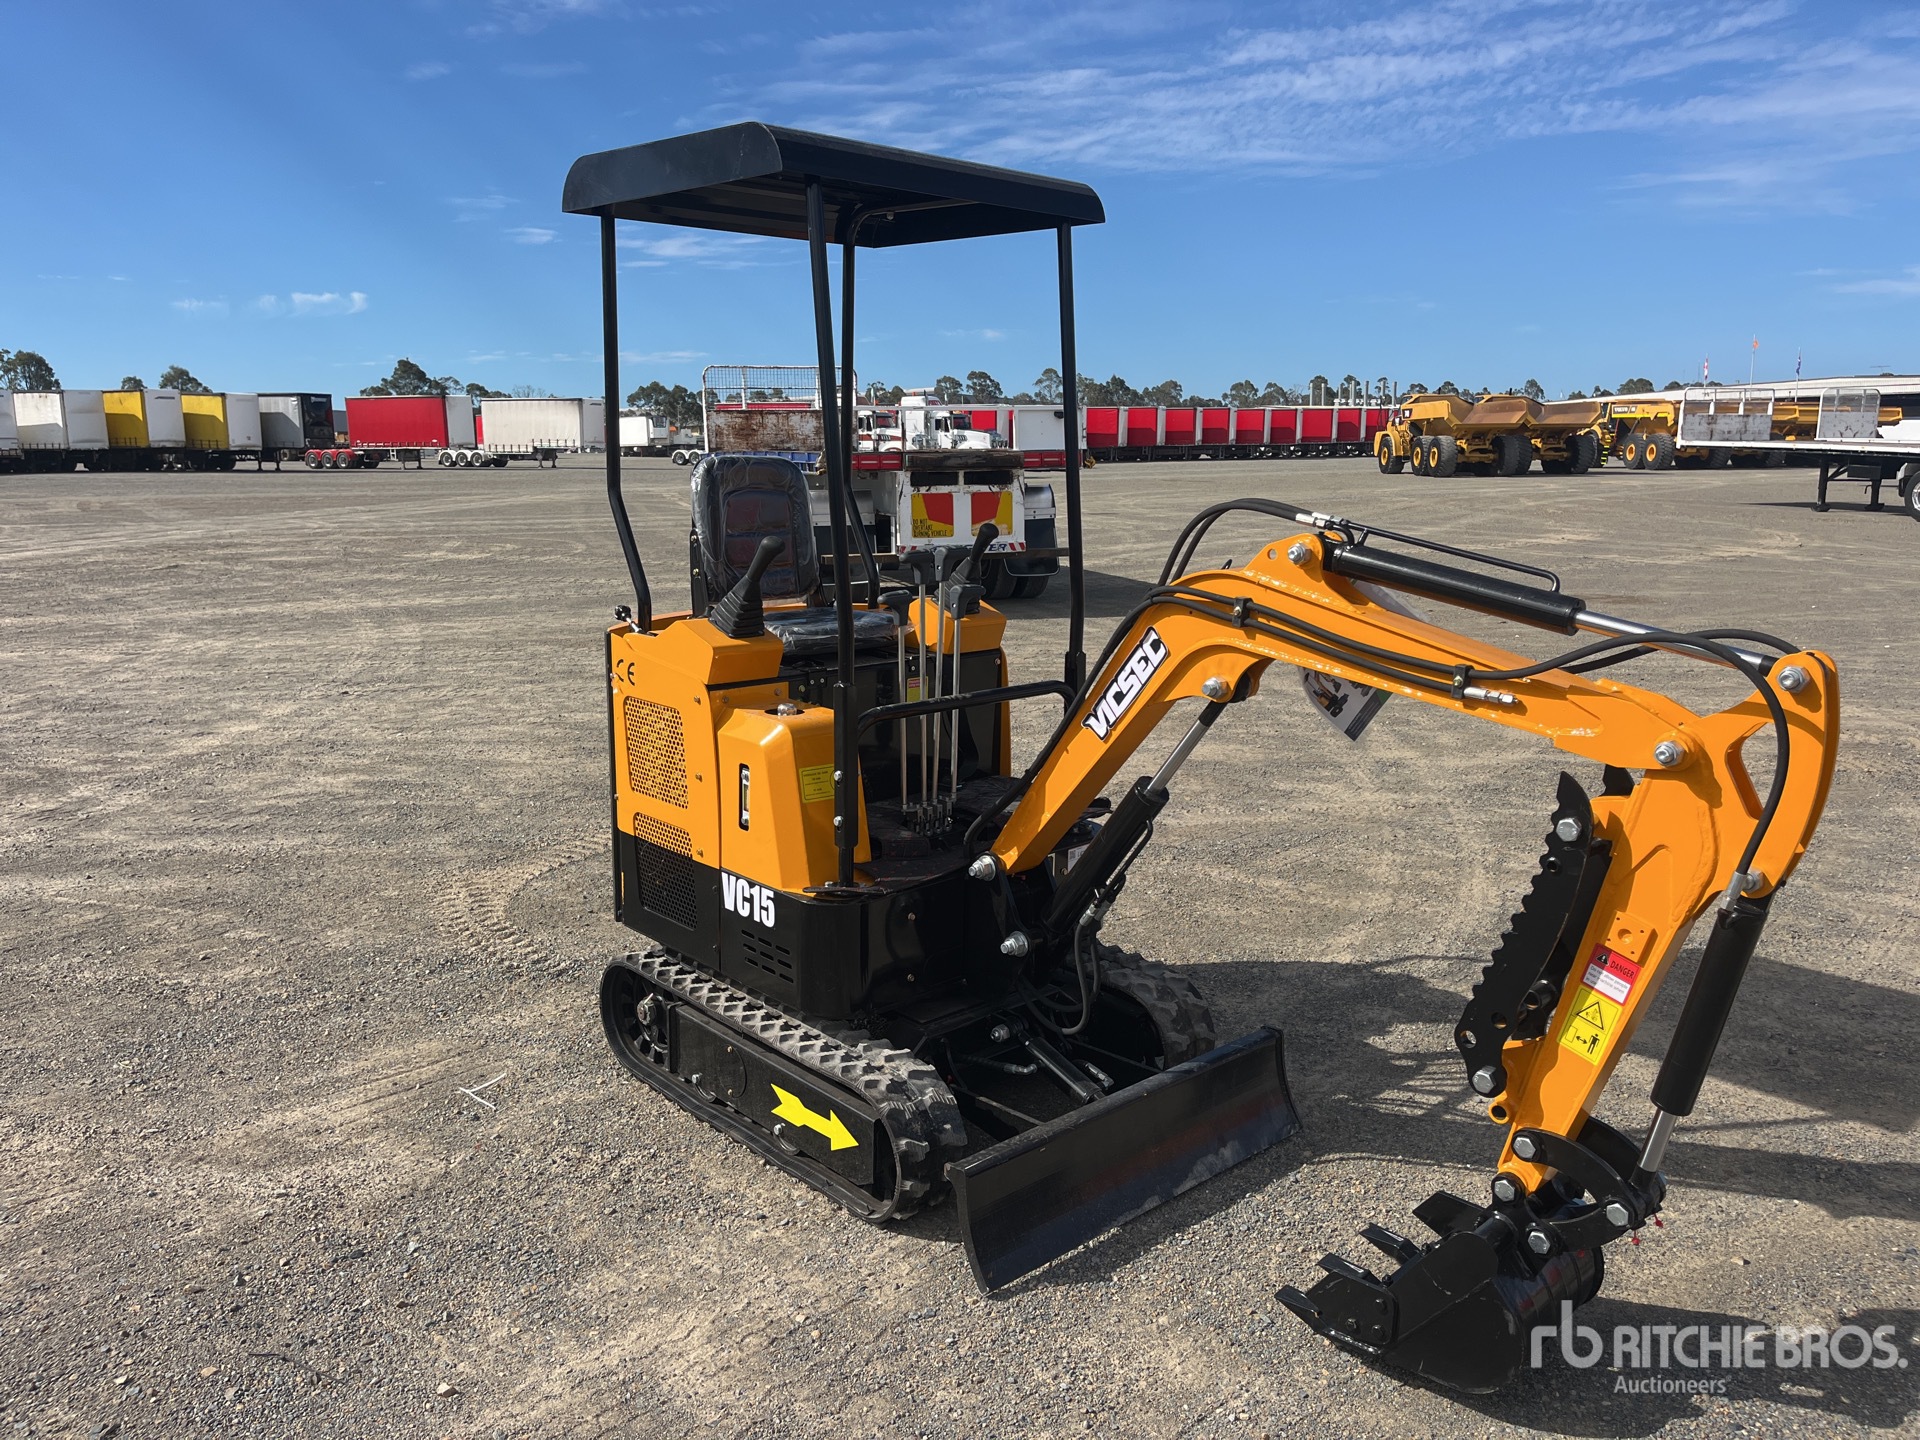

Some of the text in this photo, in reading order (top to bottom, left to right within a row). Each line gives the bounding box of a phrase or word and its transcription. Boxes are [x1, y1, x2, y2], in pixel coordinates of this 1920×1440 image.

[1082, 627, 1166, 740] VICSEC
[721, 871, 776, 928] VC15
[1610, 960, 1635, 979] DANGER
